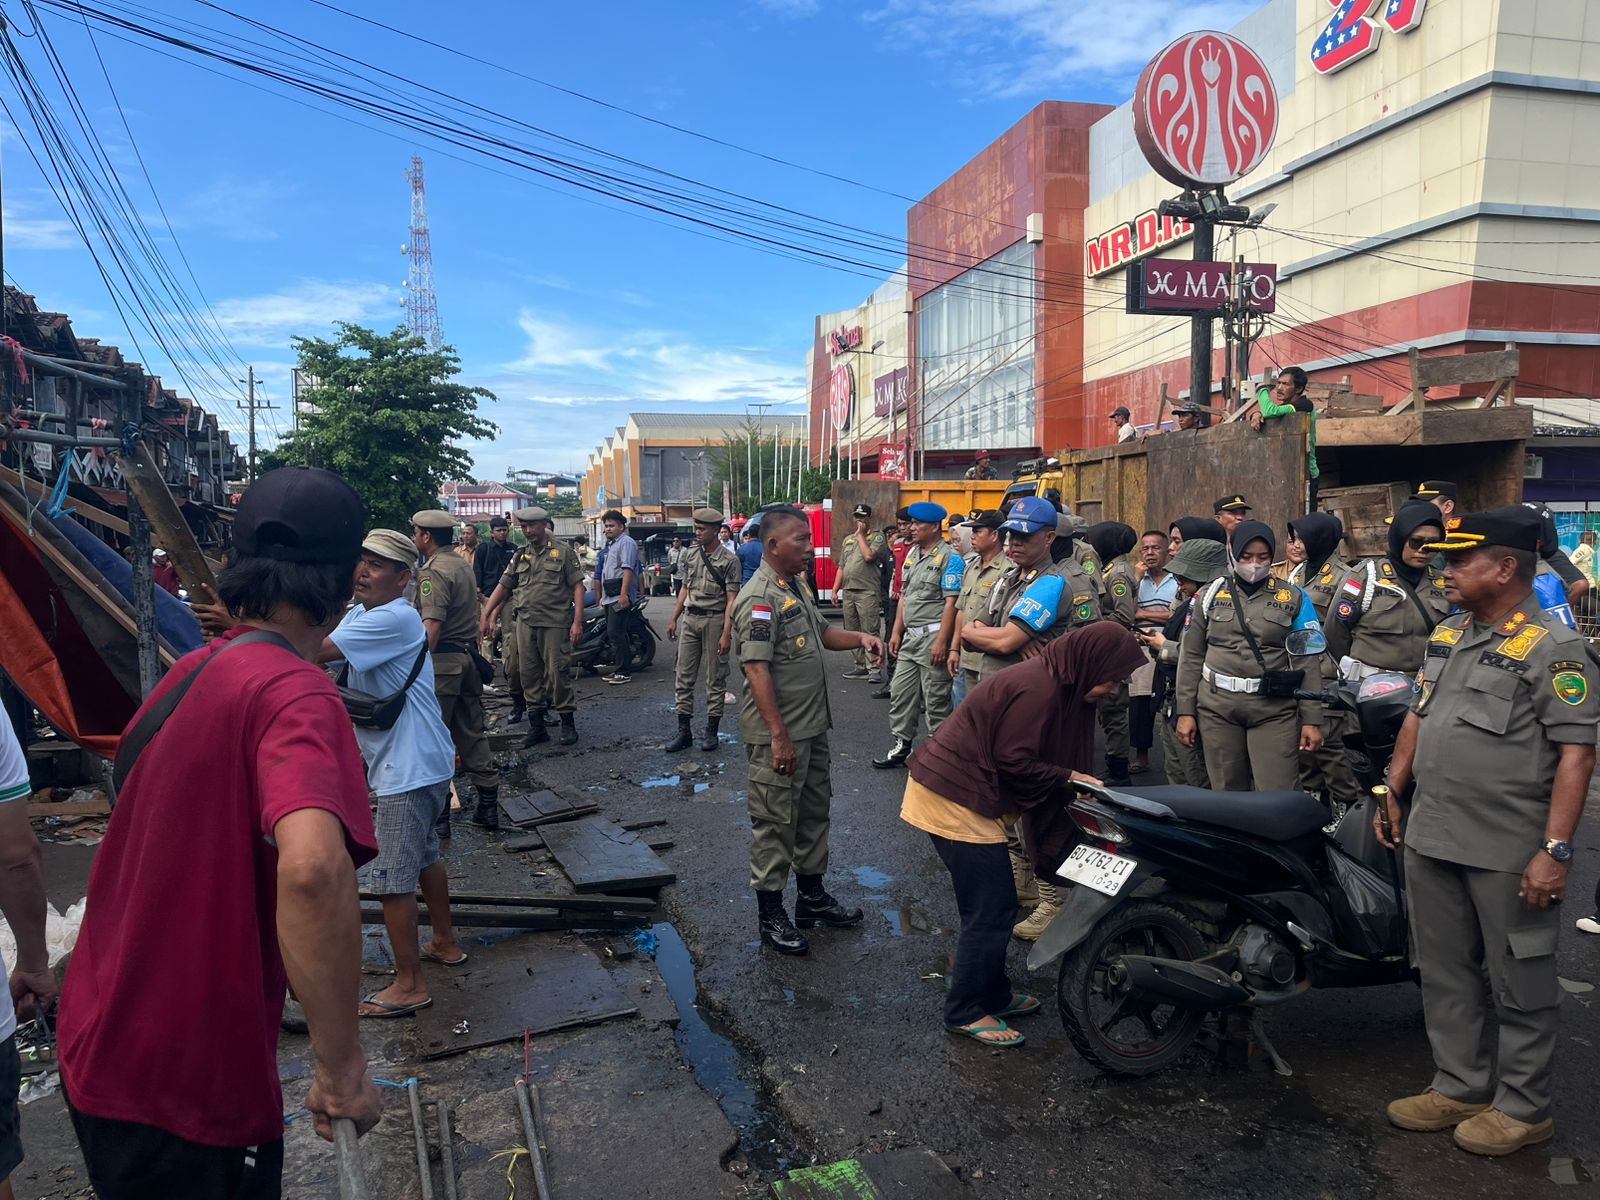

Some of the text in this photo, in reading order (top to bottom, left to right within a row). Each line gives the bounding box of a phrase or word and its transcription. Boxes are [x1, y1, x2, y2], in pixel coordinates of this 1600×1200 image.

[1087, 228, 1133, 277] MR
[1070, 846, 1130, 876] BD 4762 CI
